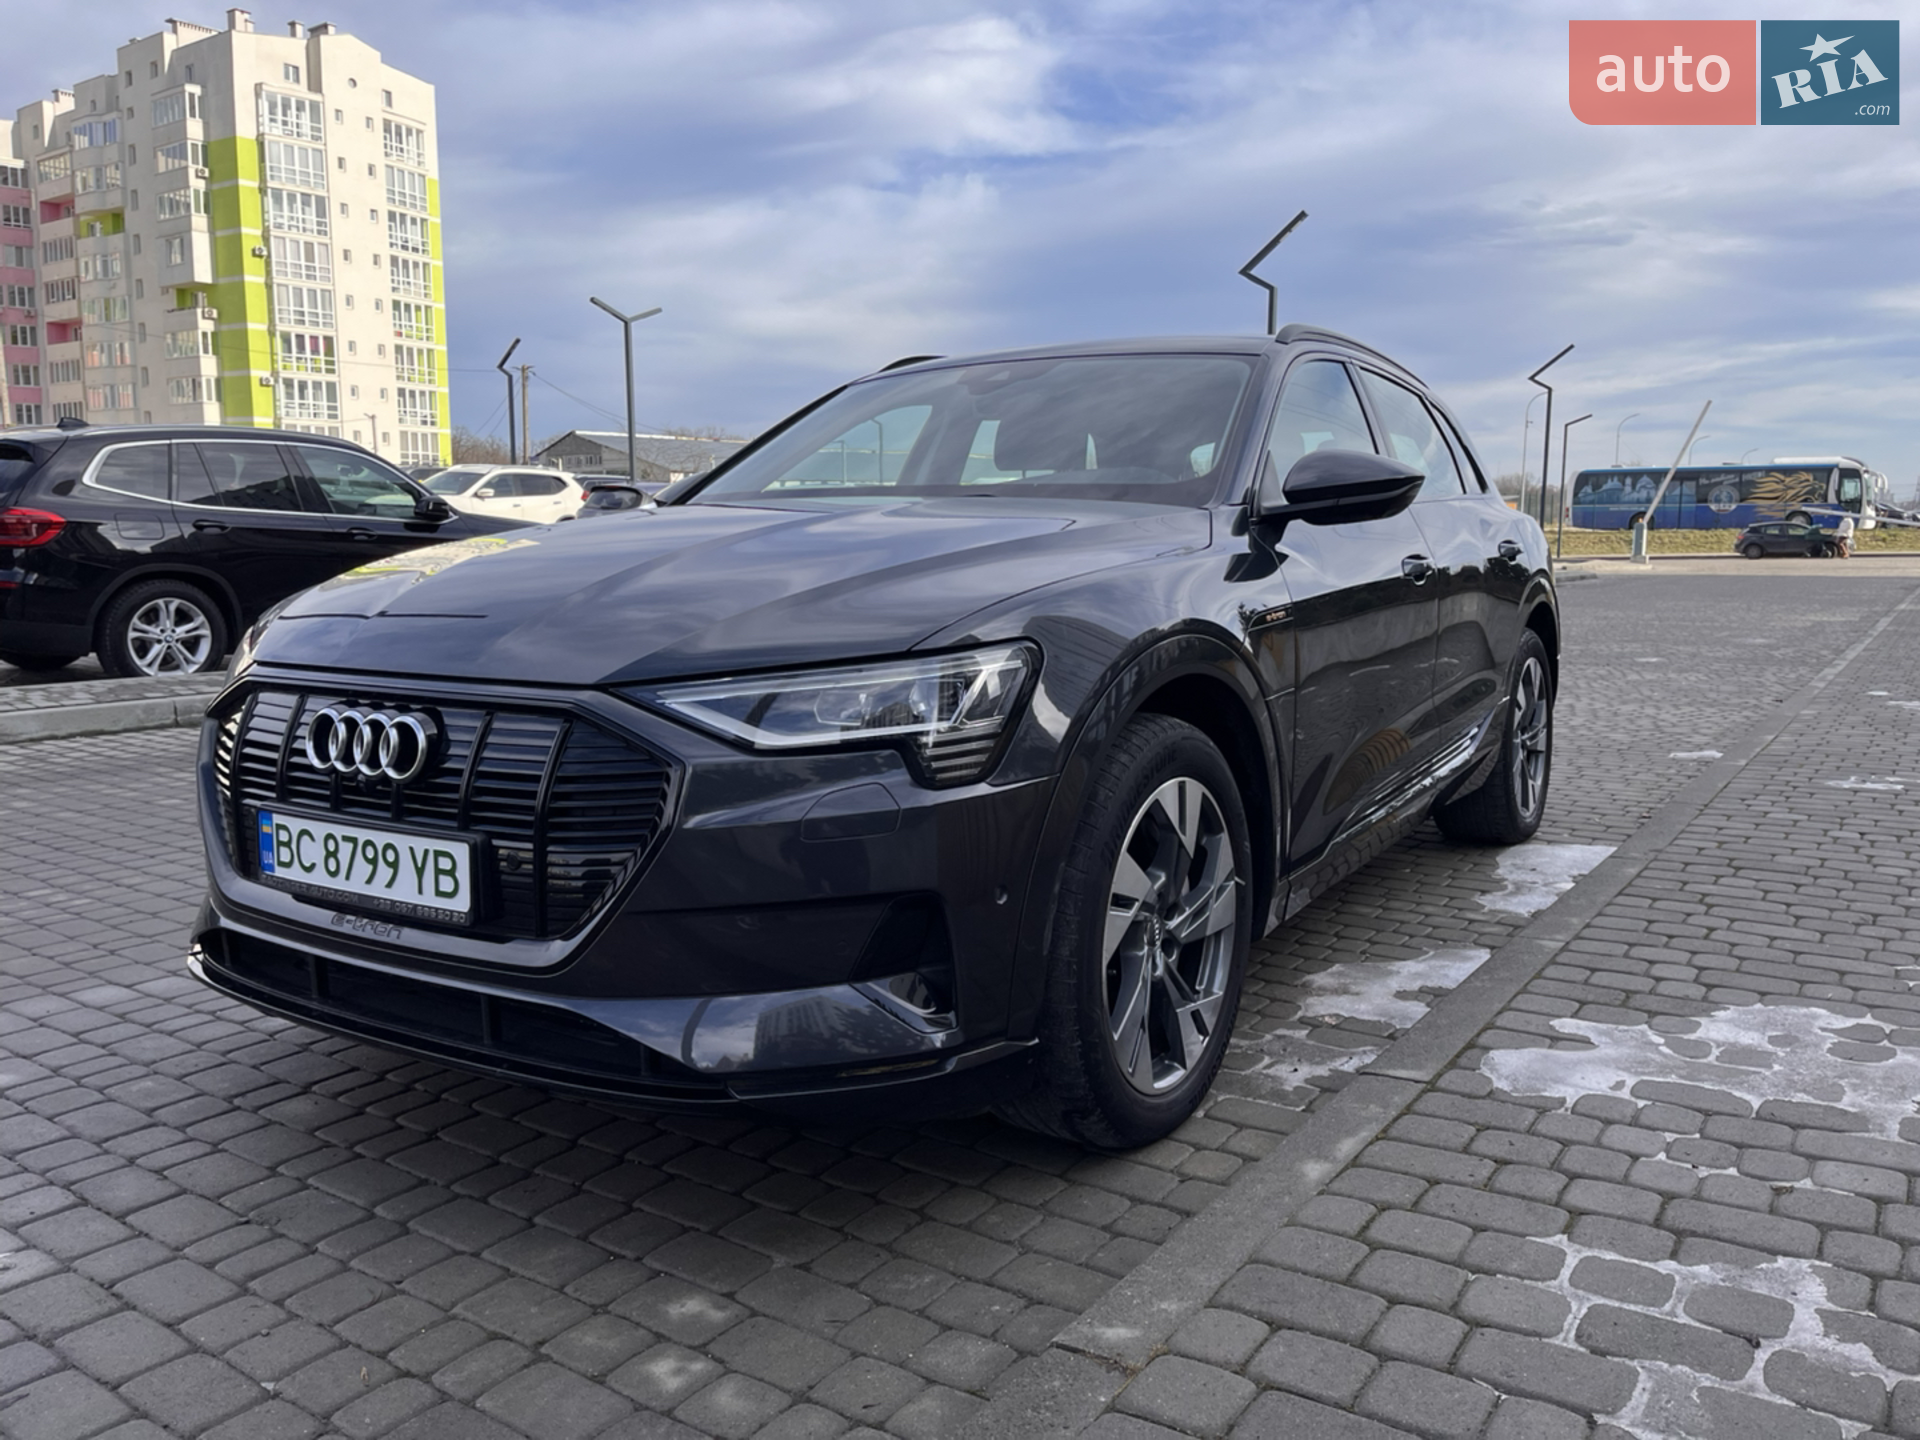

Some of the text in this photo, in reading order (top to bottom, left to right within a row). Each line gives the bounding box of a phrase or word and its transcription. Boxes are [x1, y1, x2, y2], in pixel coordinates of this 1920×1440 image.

[263, 850, 275, 864] UA
[275, 822, 459, 899] BC 8799 YB
